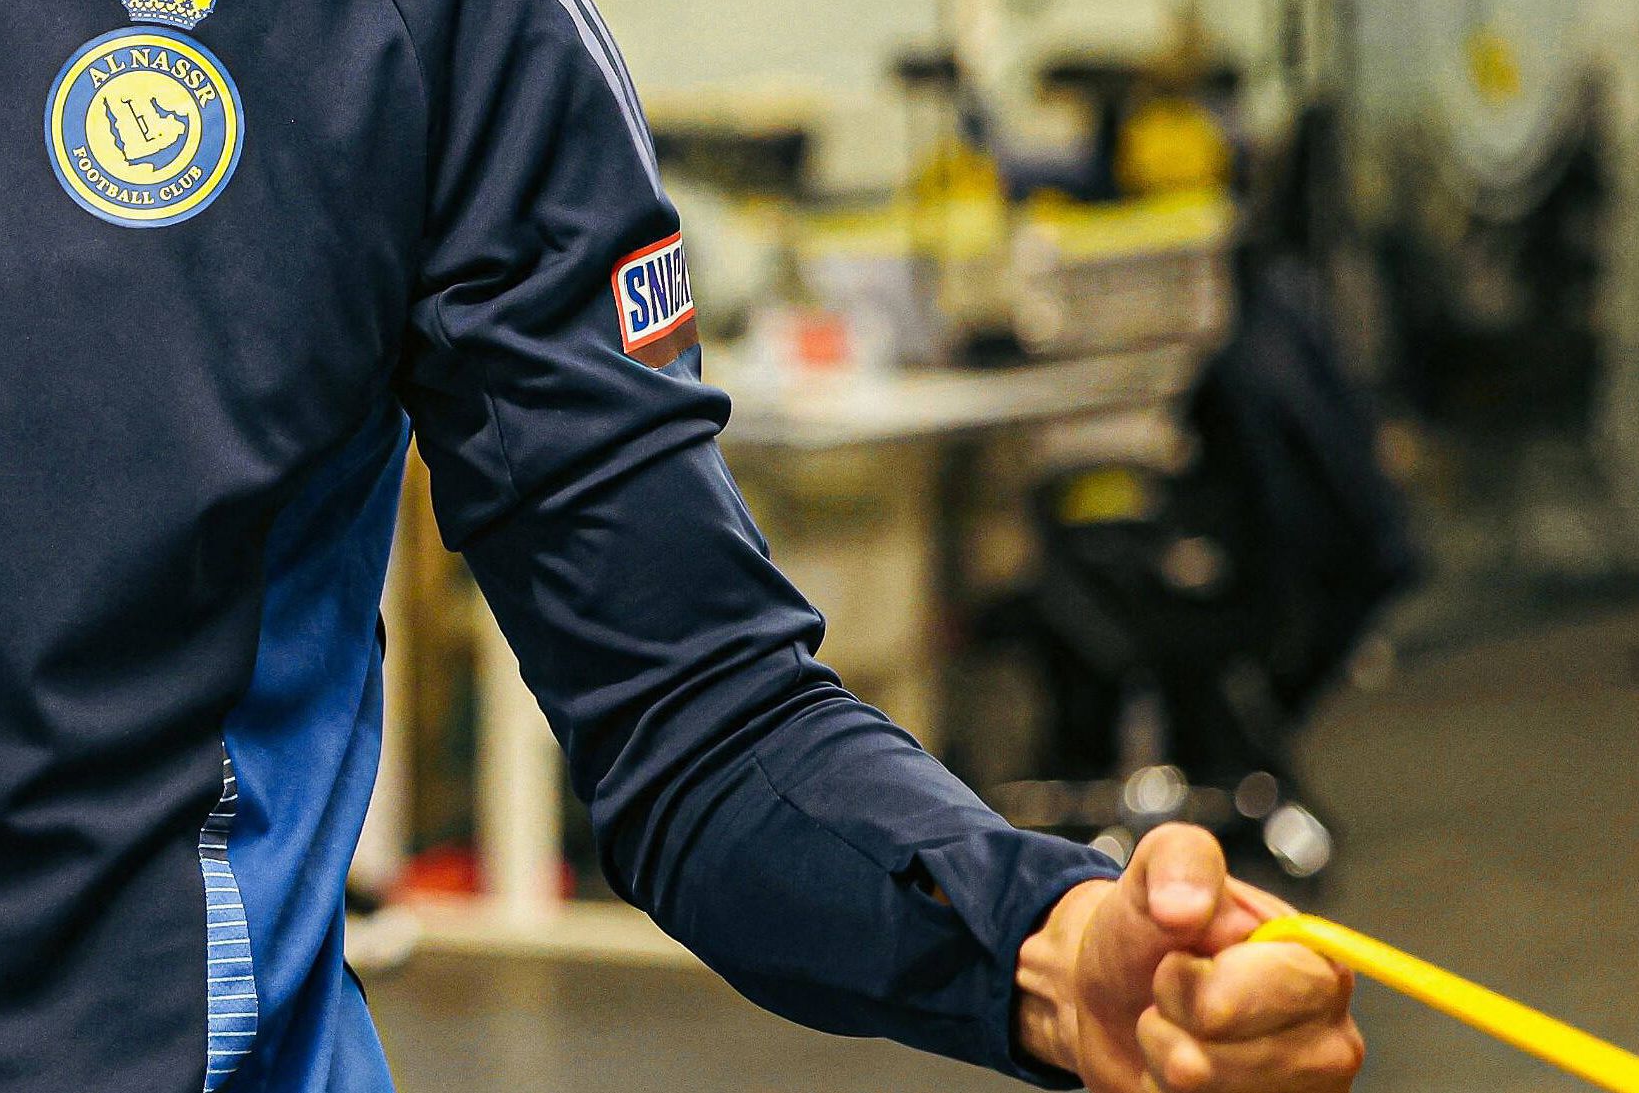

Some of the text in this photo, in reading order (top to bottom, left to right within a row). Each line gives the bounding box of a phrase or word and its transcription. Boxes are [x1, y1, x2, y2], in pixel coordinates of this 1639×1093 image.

[88, 48, 216, 109] AL NASSR
[72, 146, 203, 205] FOOTBALL CLUB
